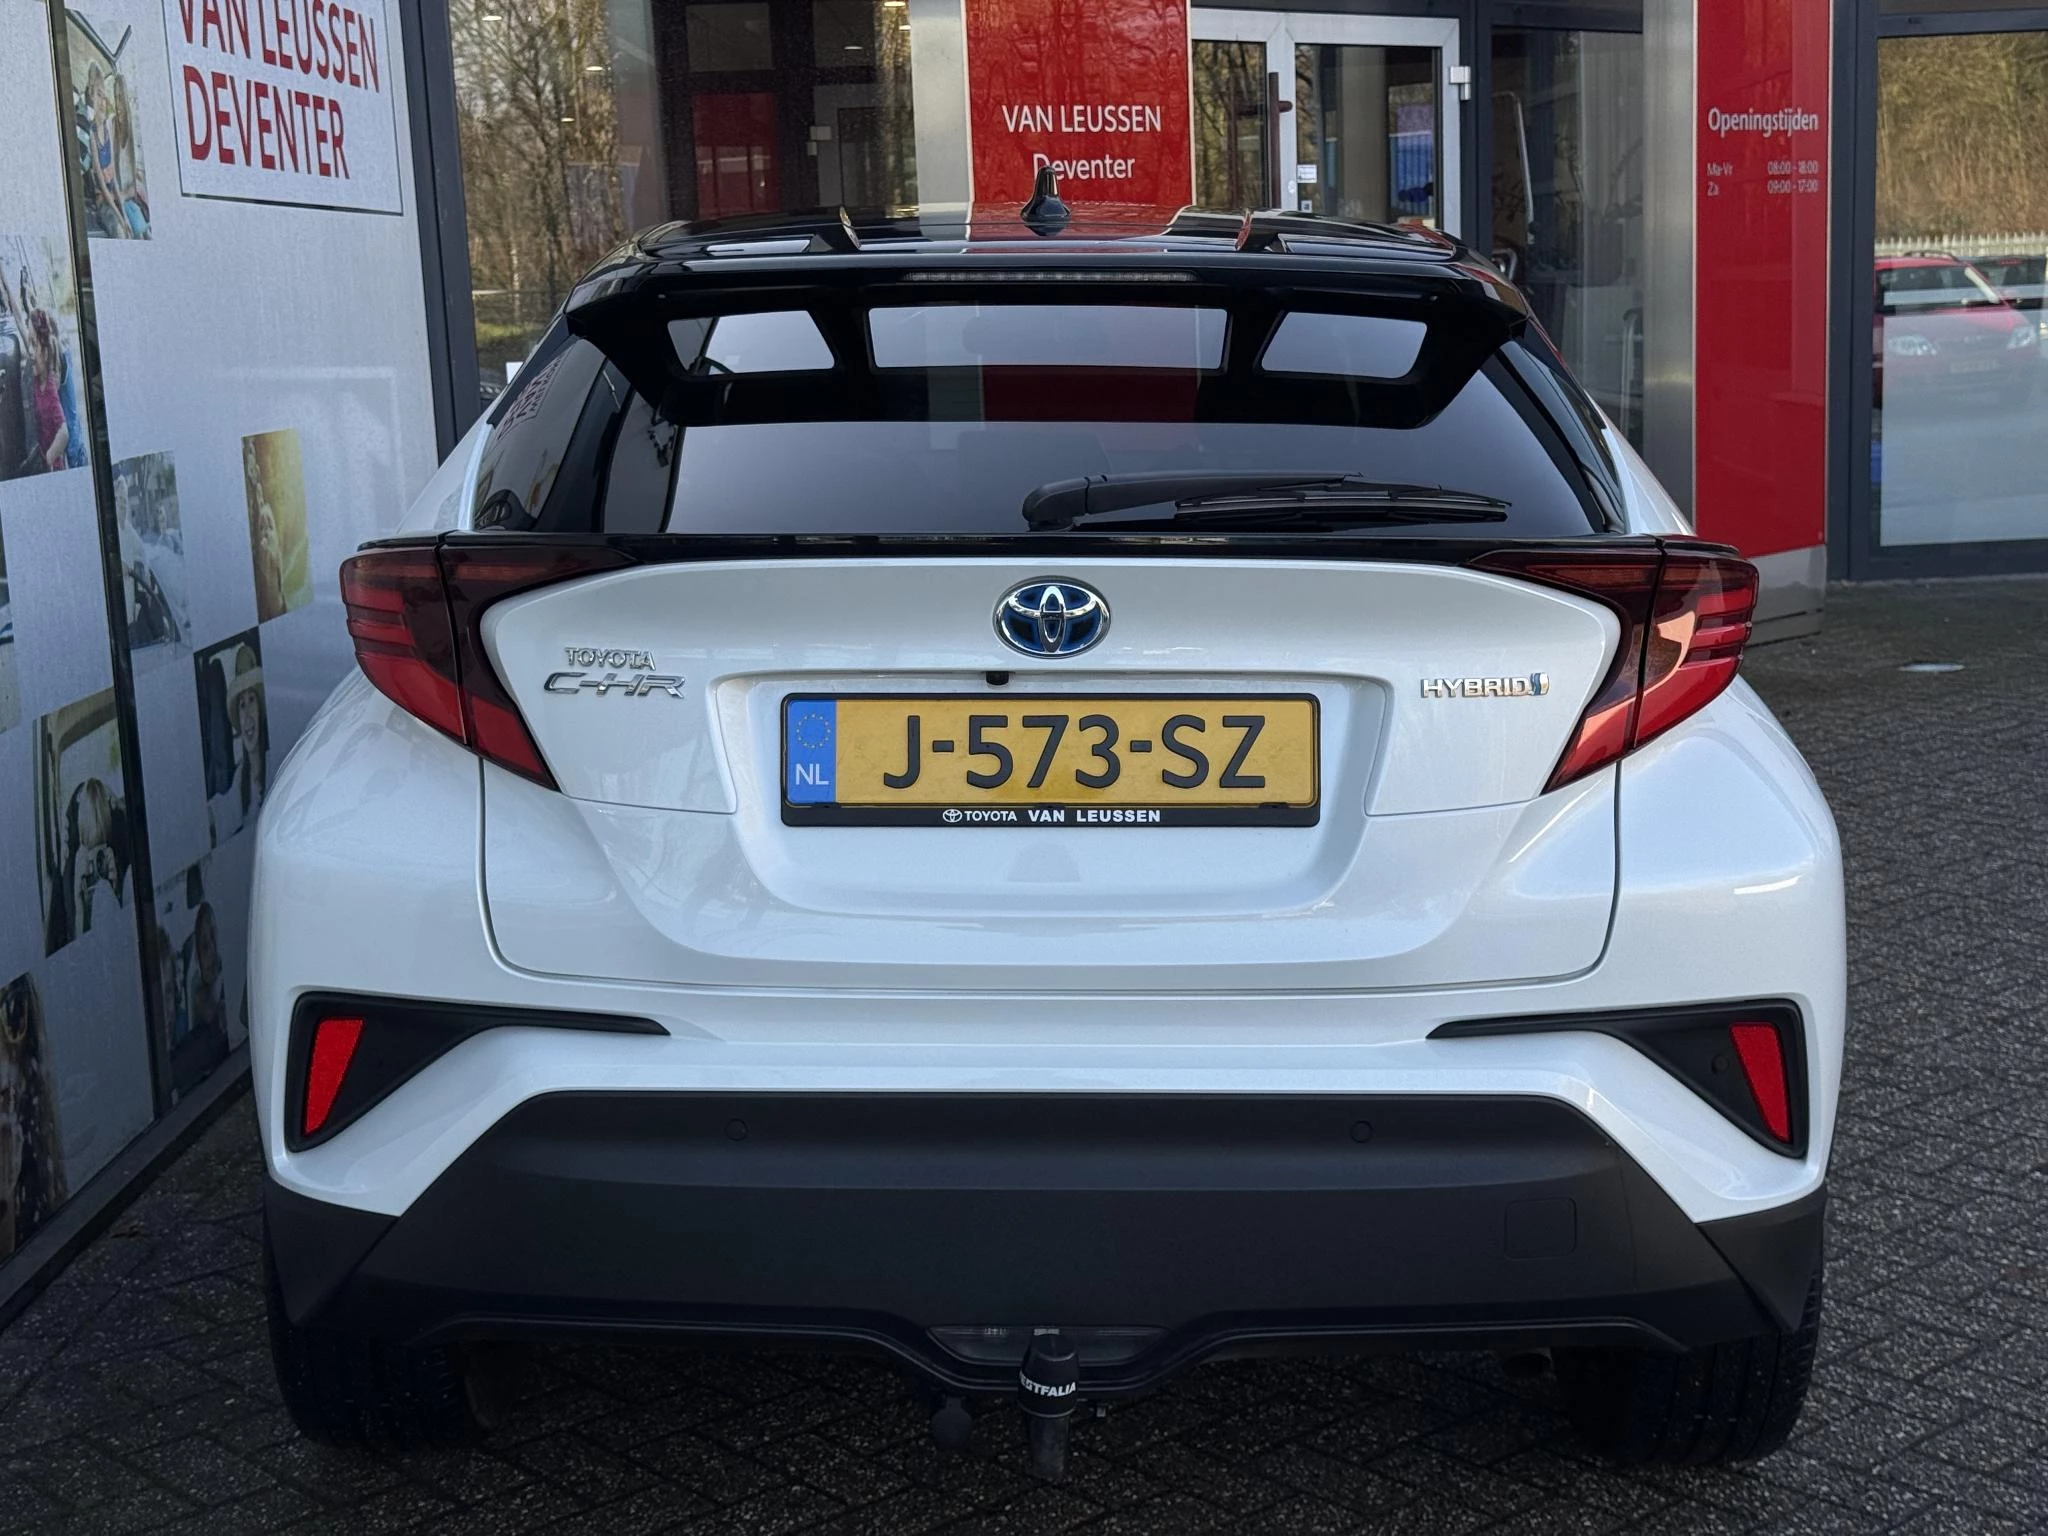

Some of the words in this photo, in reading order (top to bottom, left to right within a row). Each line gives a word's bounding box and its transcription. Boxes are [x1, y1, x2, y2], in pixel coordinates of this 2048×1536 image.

[258, 0, 380, 94] LEUSSEN
[183, 64, 350, 180] DEVENTER
[1002, 104, 1053, 133] VAN
[1060, 104, 1162, 133] LEUSSEN
[1708, 106, 1819, 138] Openingstijden
[1033, 153, 1136, 180] Deventer
[564, 646, 656, 672] TOYOTA
[543, 671, 686, 699] C-HR
[1420, 677, 1531, 698] HYBRID
[883, 714, 1267, 790] J-573-SZ
[795, 762, 830, 786] NL
[964, 810, 1018, 822] TOYOTA
[1027, 809, 1065, 823] VAN
[1076, 809, 1161, 823] LEUSSEN
[1019, 1369, 1077, 1398] ESTFALIA
